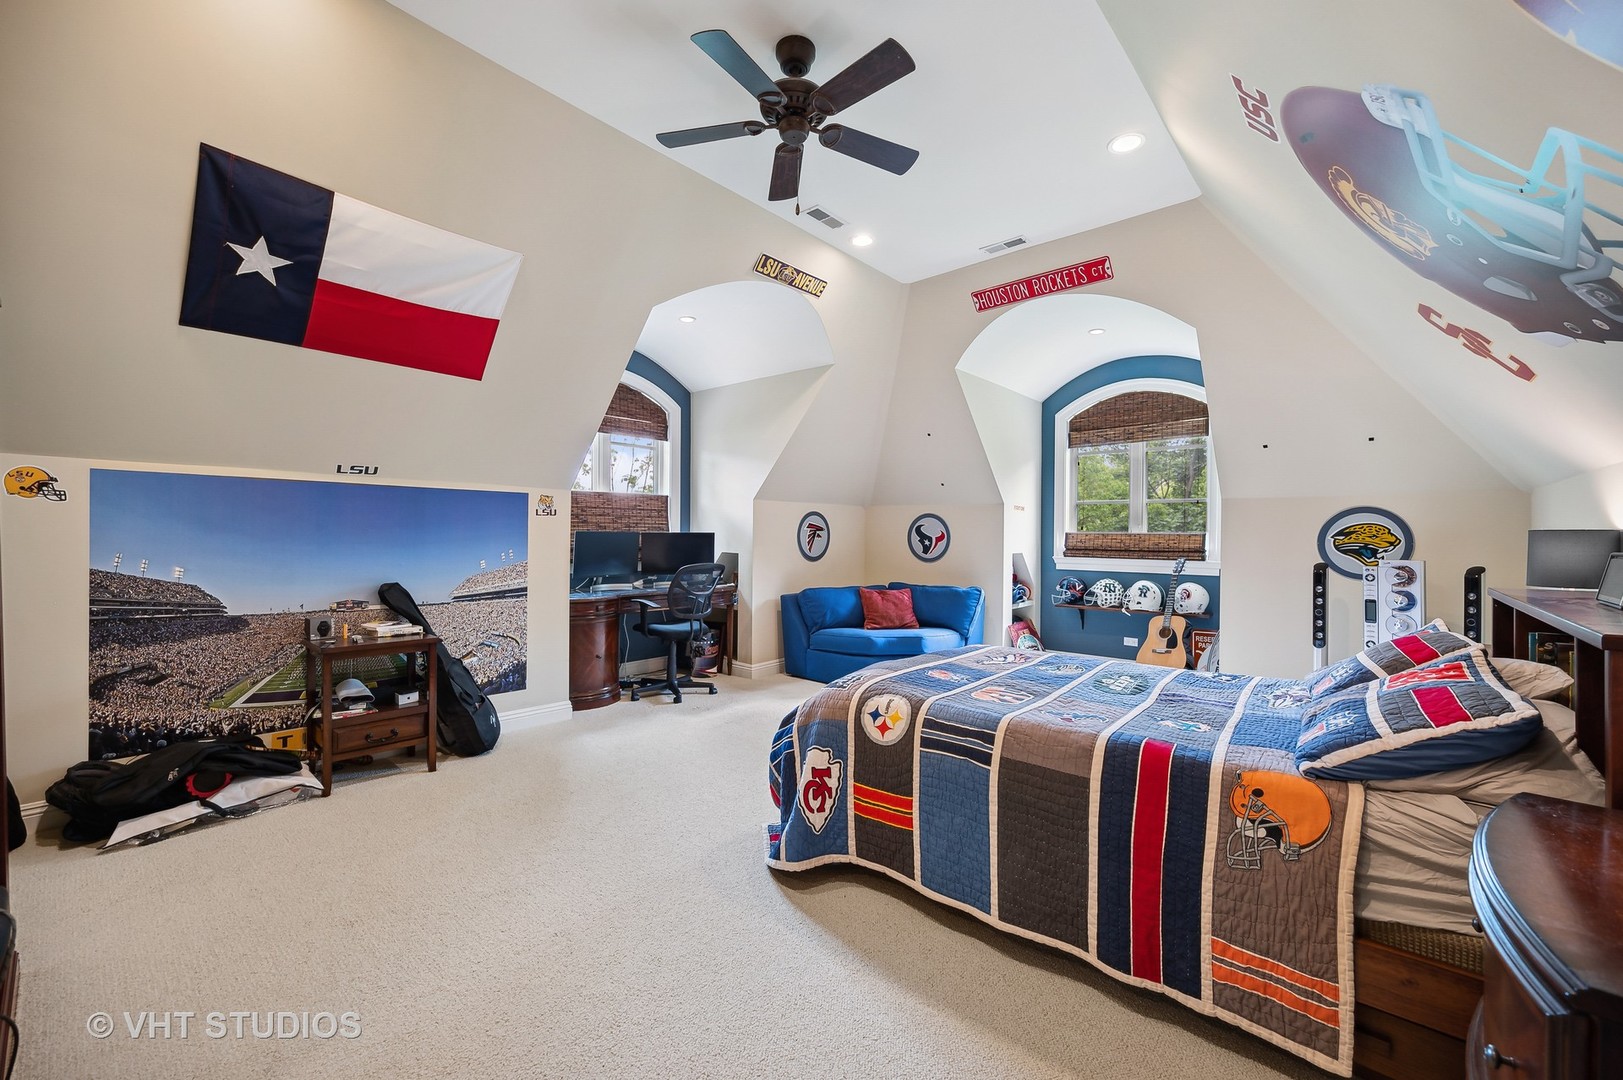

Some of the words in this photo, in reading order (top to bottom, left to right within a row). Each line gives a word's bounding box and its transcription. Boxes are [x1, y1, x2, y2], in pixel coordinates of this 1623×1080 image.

[1230, 73, 1280, 143] USC
[757, 255, 782, 278] LSU
[792, 272, 828, 296] AVENUE
[977, 283, 1030, 309] HOUSTON
[1032, 266, 1088, 296] ROCKETS
[7, 470, 34, 478] LSU
[336, 464, 379, 475] LSU
[535, 508, 557, 516] LSU
